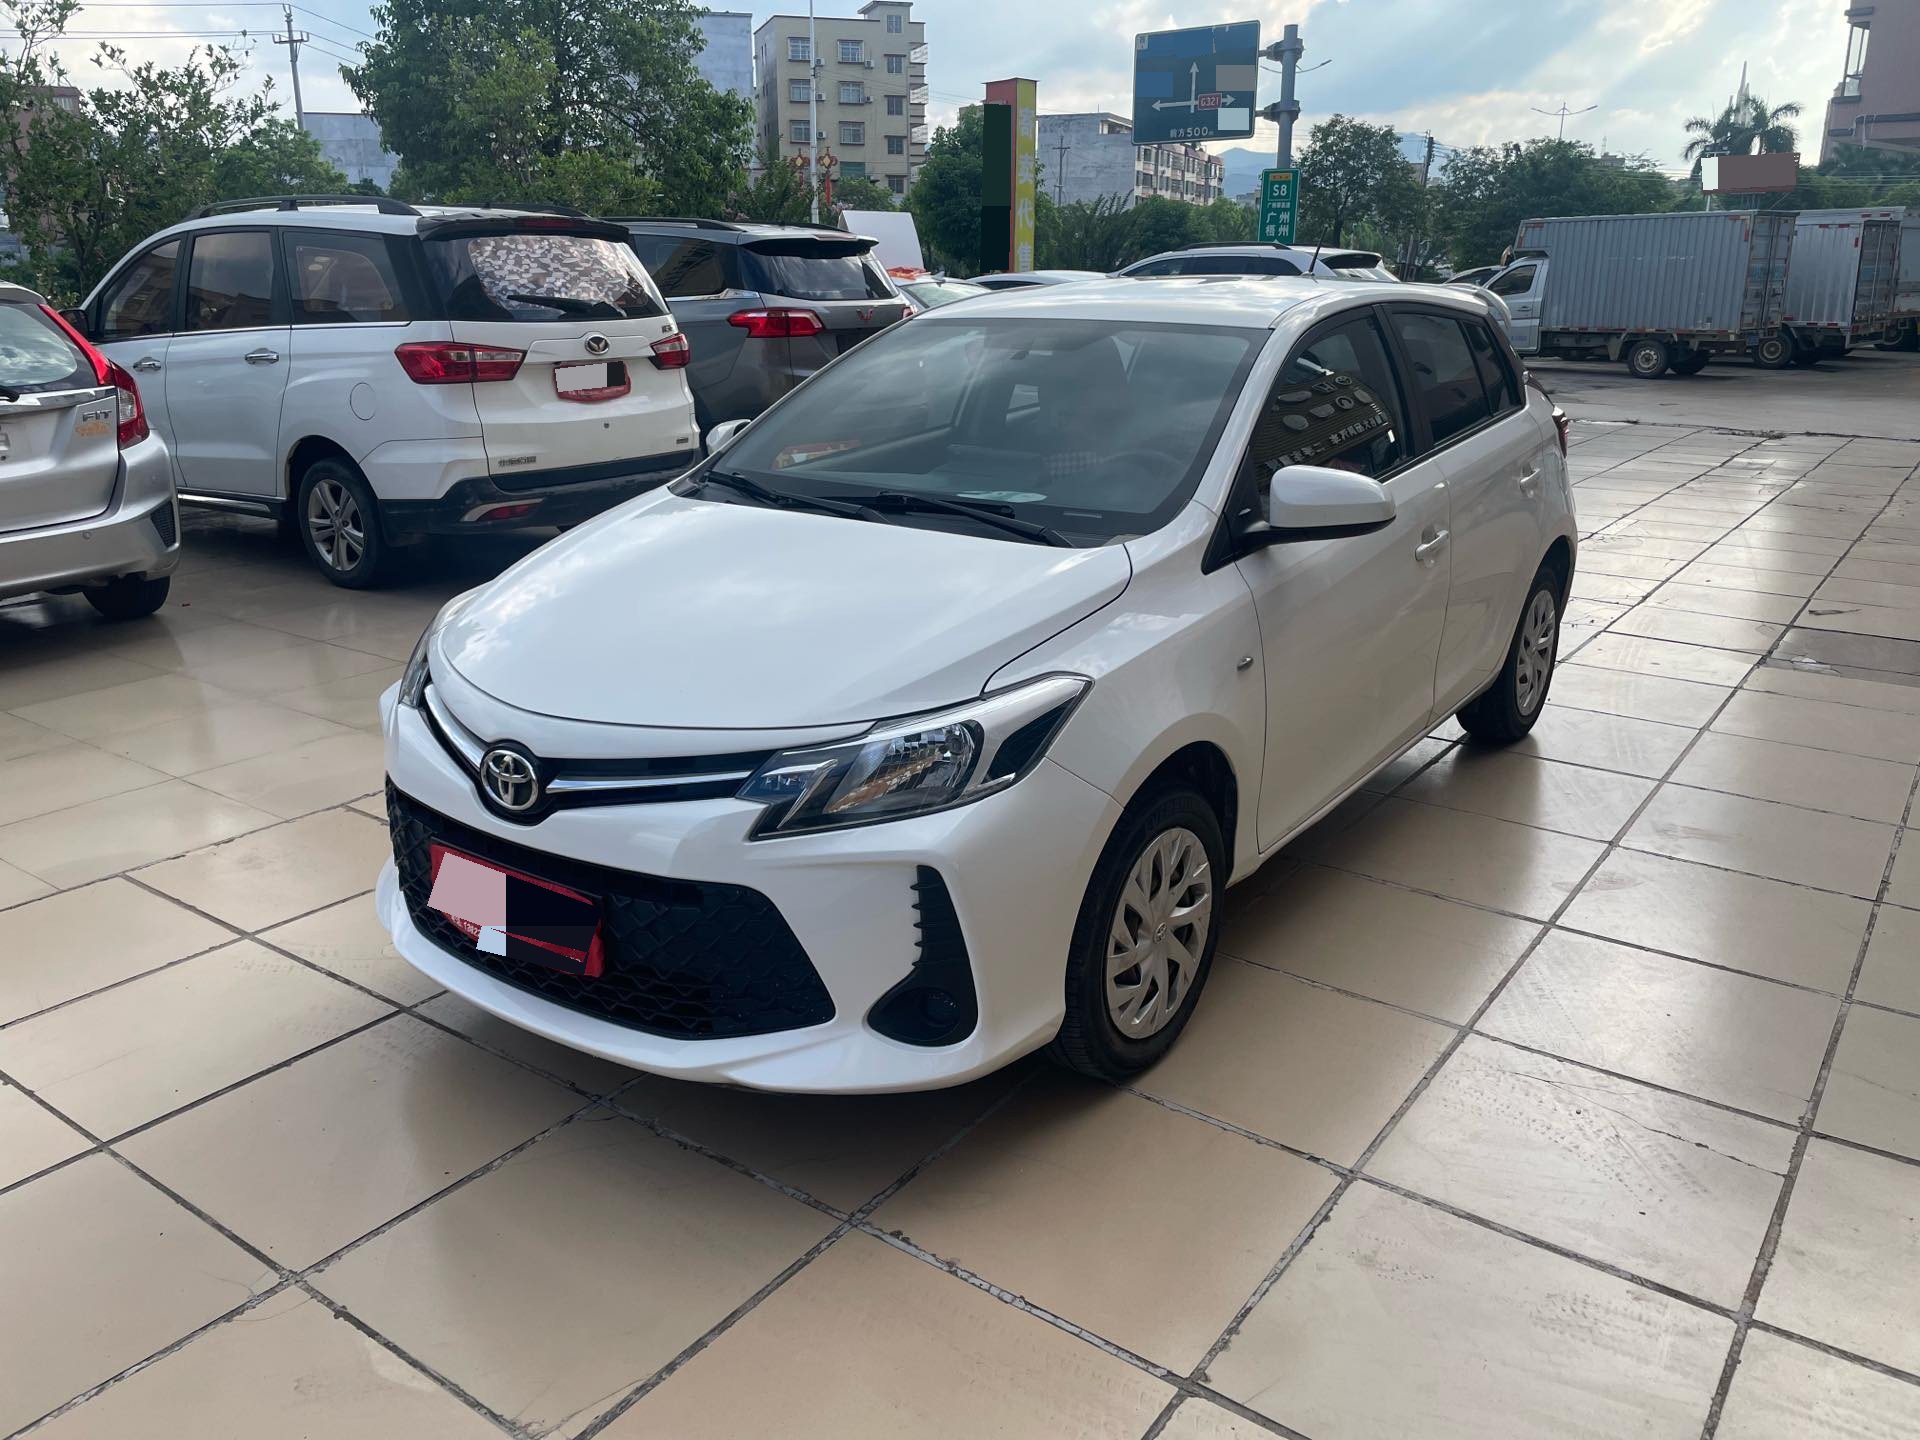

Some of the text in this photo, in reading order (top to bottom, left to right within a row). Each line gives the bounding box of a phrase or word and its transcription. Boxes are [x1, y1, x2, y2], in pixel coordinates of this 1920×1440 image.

[1200, 96, 1219, 107] G321
[1272, 184, 1288, 197] S8
[1265, 211, 1290, 224] 广州
[82, 410, 113, 422] FIT
